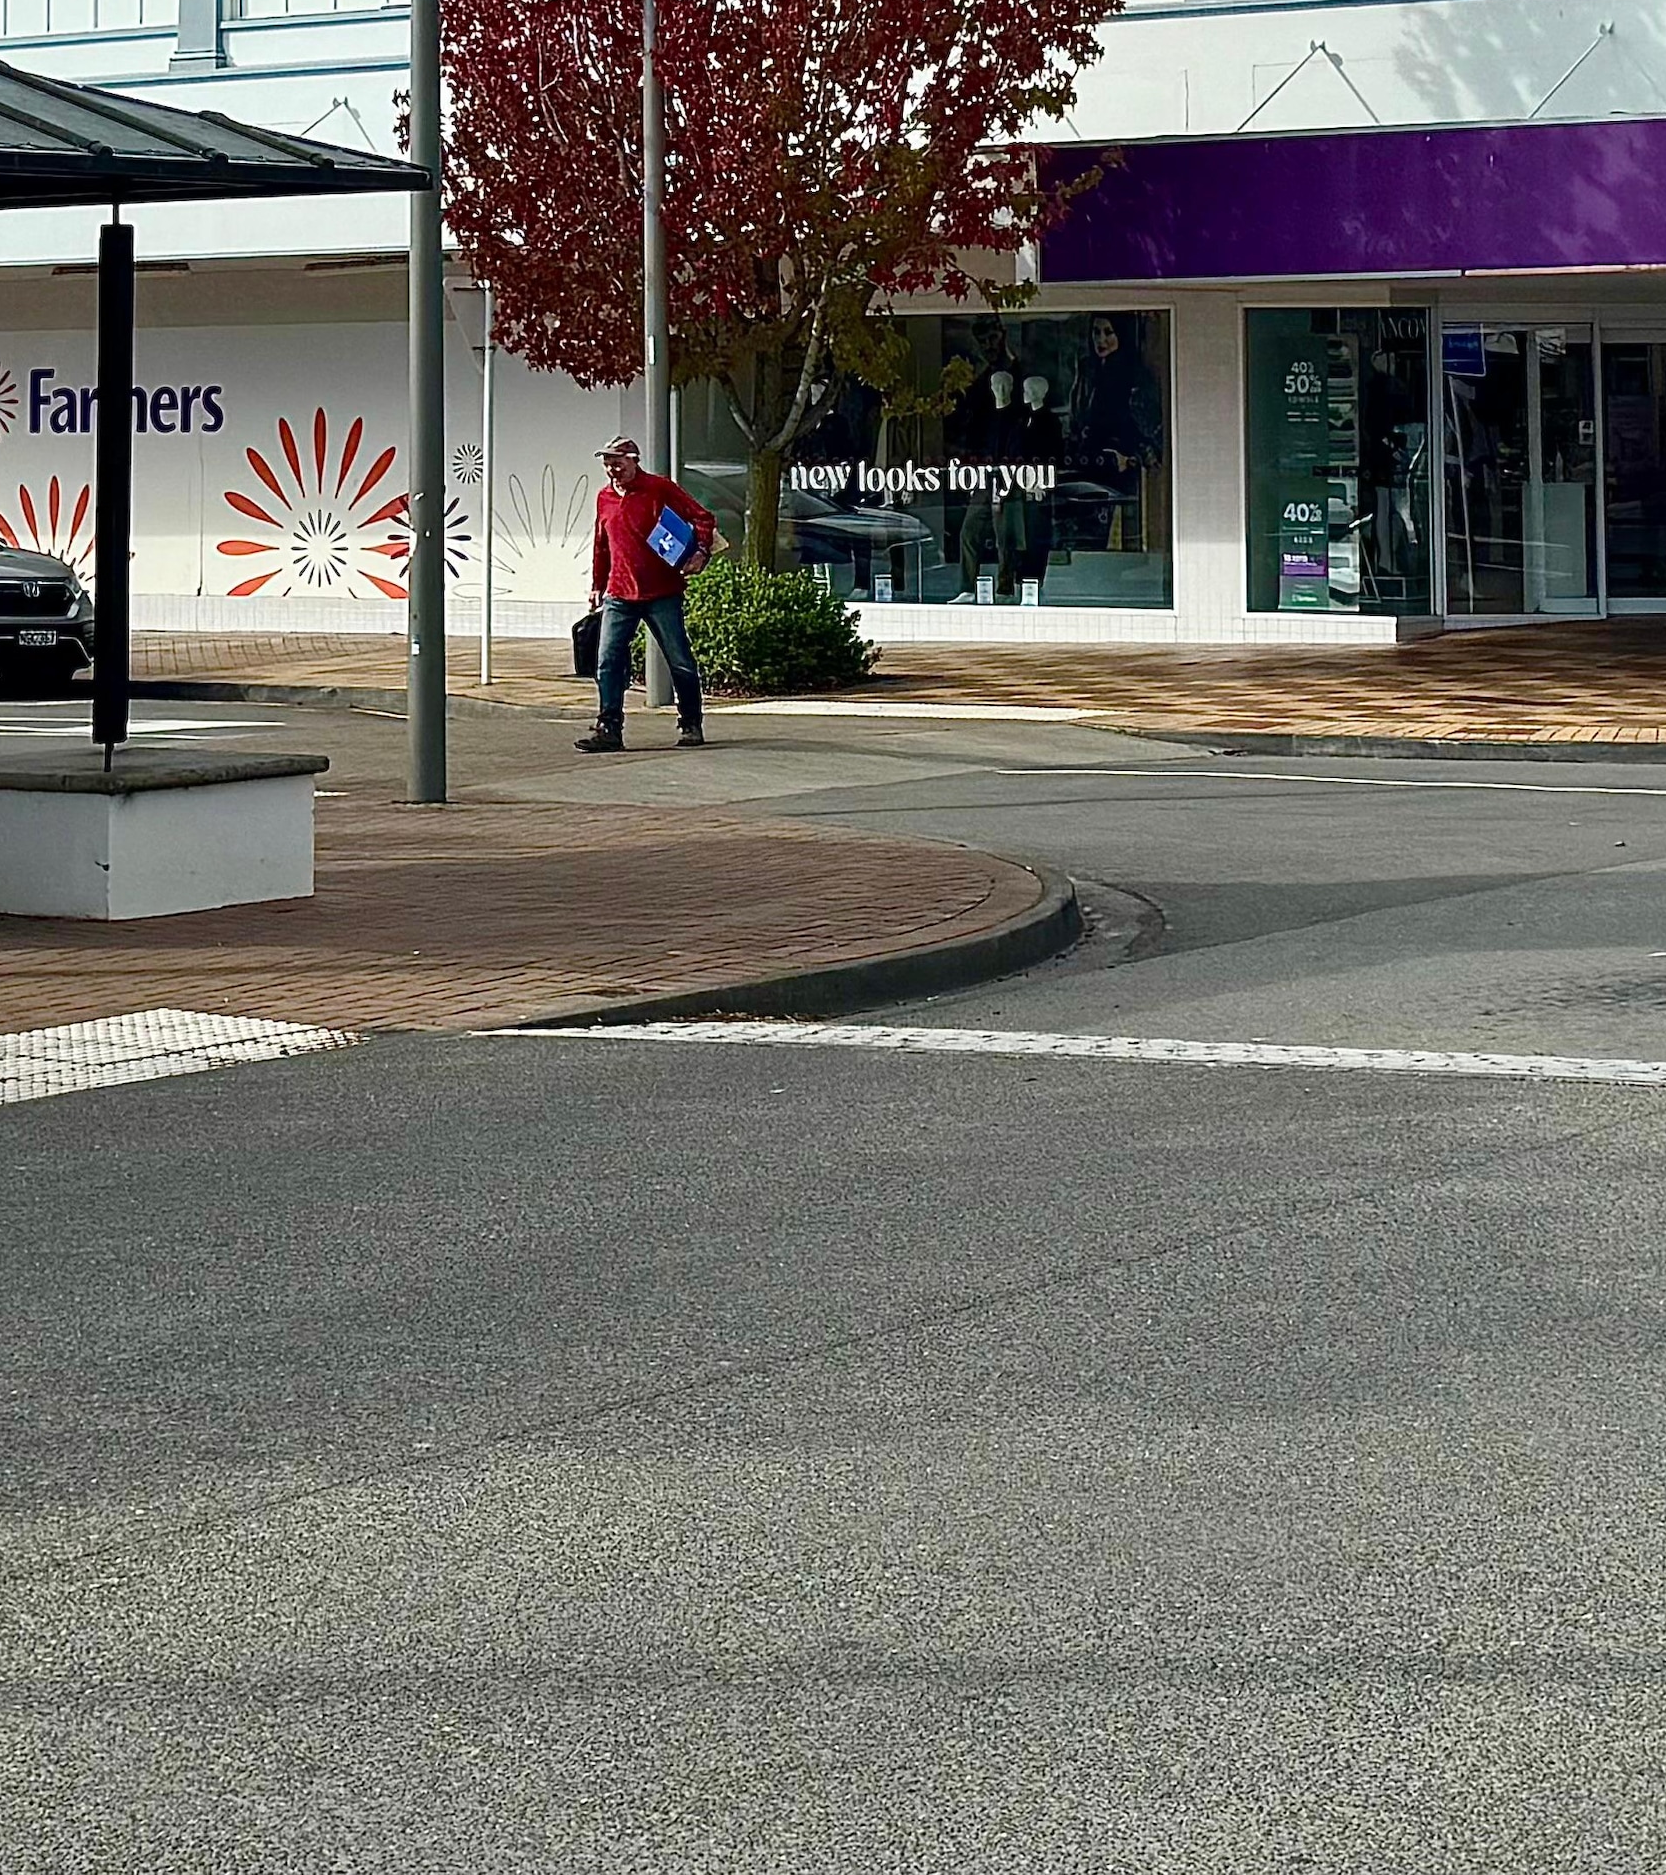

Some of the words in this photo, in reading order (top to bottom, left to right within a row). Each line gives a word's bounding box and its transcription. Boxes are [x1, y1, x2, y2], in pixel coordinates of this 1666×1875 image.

[790, 463, 852, 491] new
[858, 459, 941, 493] looks
[948, 457, 994, 491] for
[999, 464, 1056, 497] you
